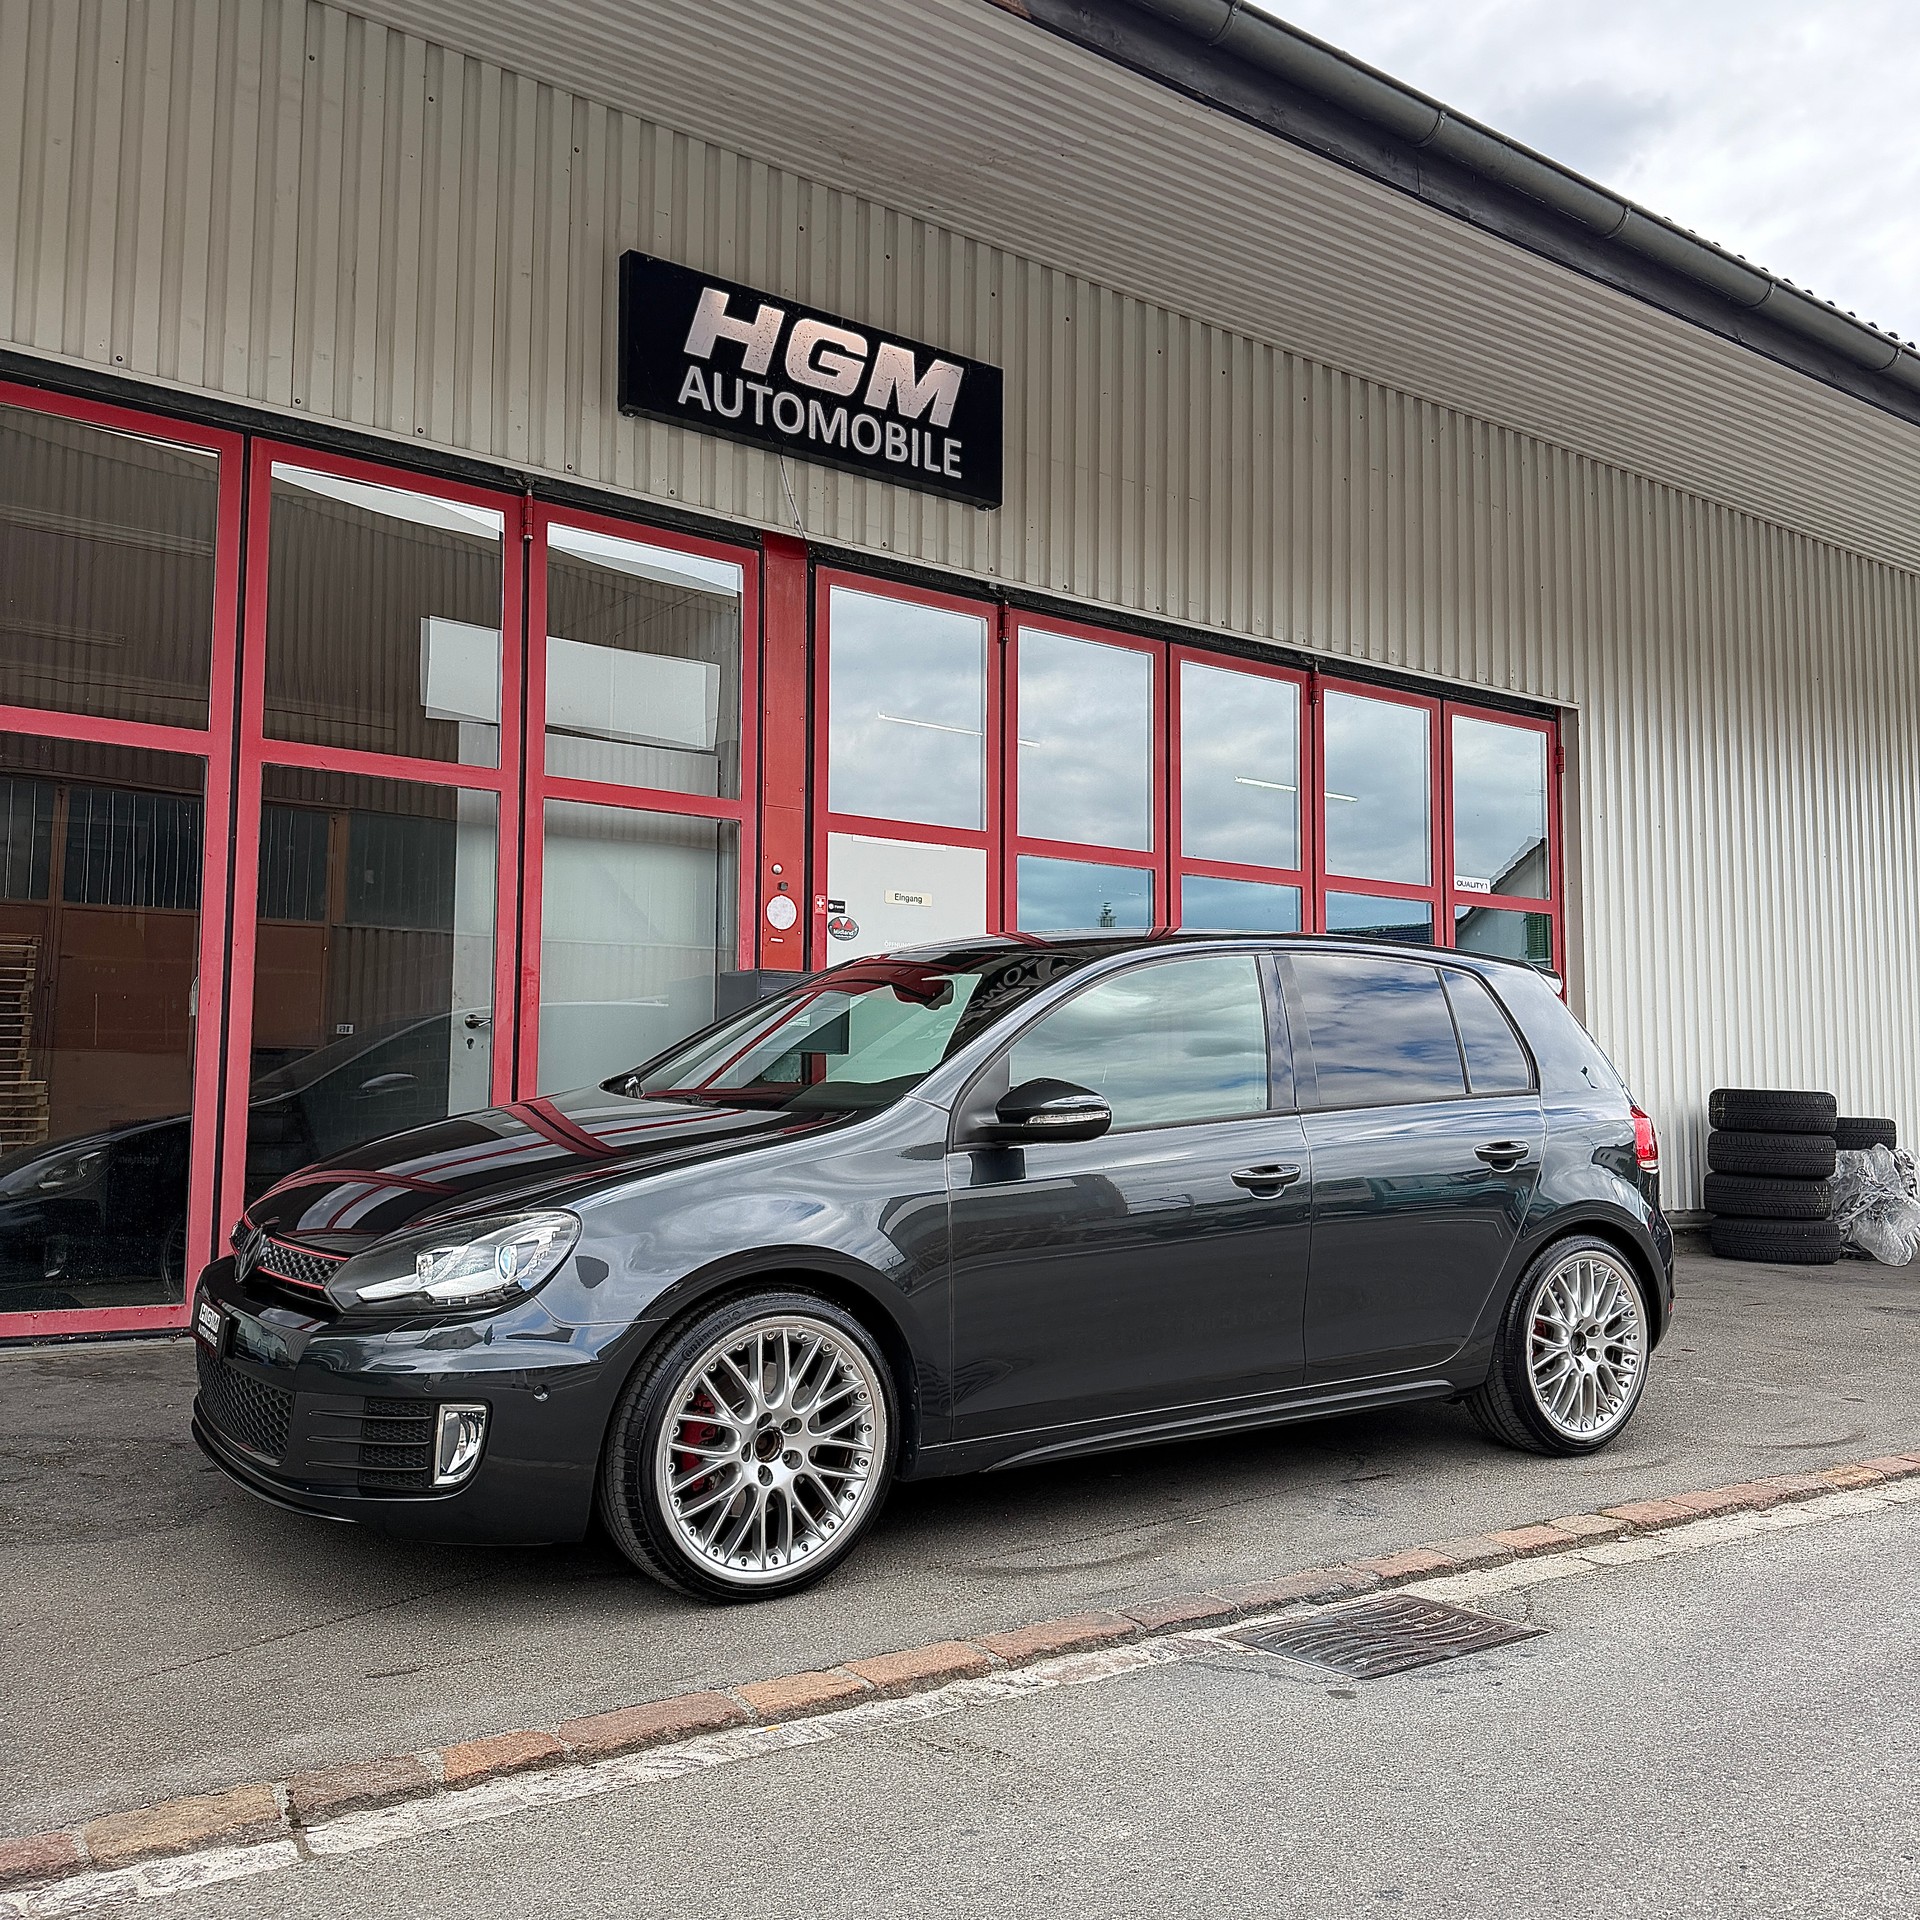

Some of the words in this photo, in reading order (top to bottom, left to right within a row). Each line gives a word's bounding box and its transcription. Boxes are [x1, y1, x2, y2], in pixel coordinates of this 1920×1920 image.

[684, 287, 963, 428] HGM
[678, 365, 962, 478] AUTOMOBILE
[894, 893, 923, 904] Eingang
[1456, 880, 1484, 889] QUALITY
